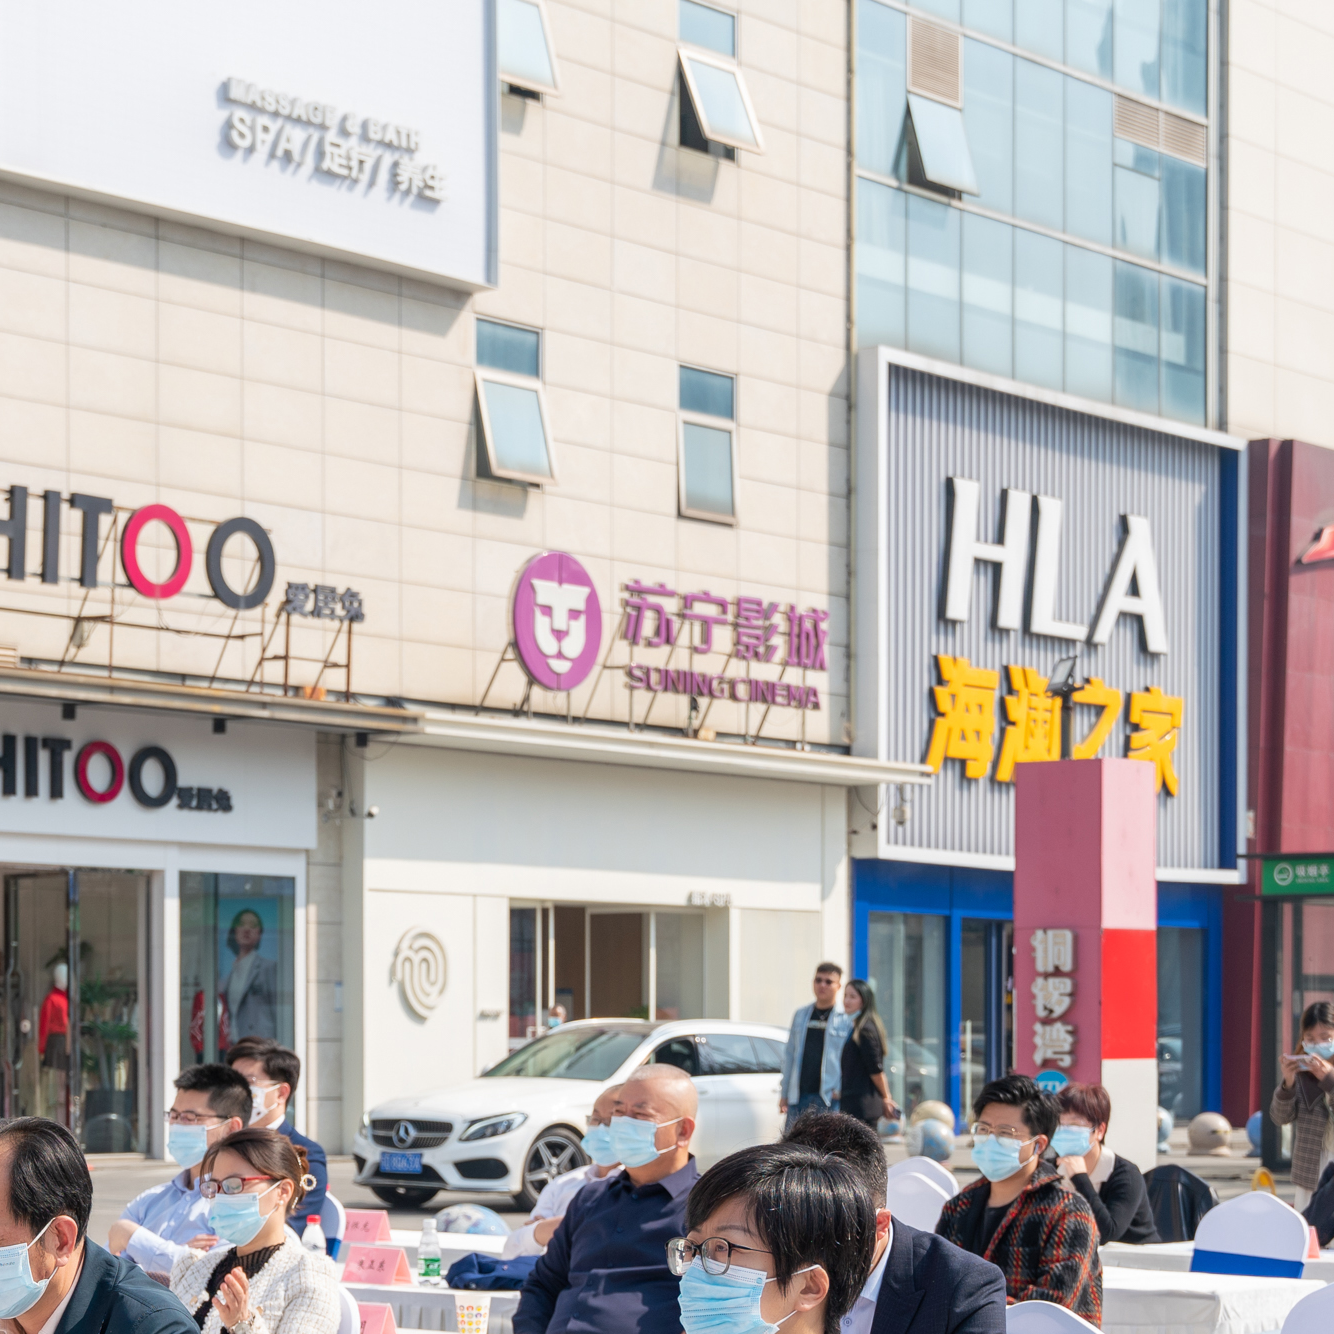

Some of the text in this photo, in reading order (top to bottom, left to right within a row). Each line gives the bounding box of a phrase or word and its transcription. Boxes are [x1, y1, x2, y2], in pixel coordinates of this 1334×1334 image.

[227, 77, 421, 152] MASSAGE & BATH
[283, 580, 366, 624] 爱居兔
[943, 477, 1169, 655] HLA
[622, 579, 830, 672] 苏宁影城
[627, 664, 821, 711] SUNING CINEMA
[925, 654, 1184, 797] 海澜之家
[1030, 928, 1076, 1069] 铜锣湾
